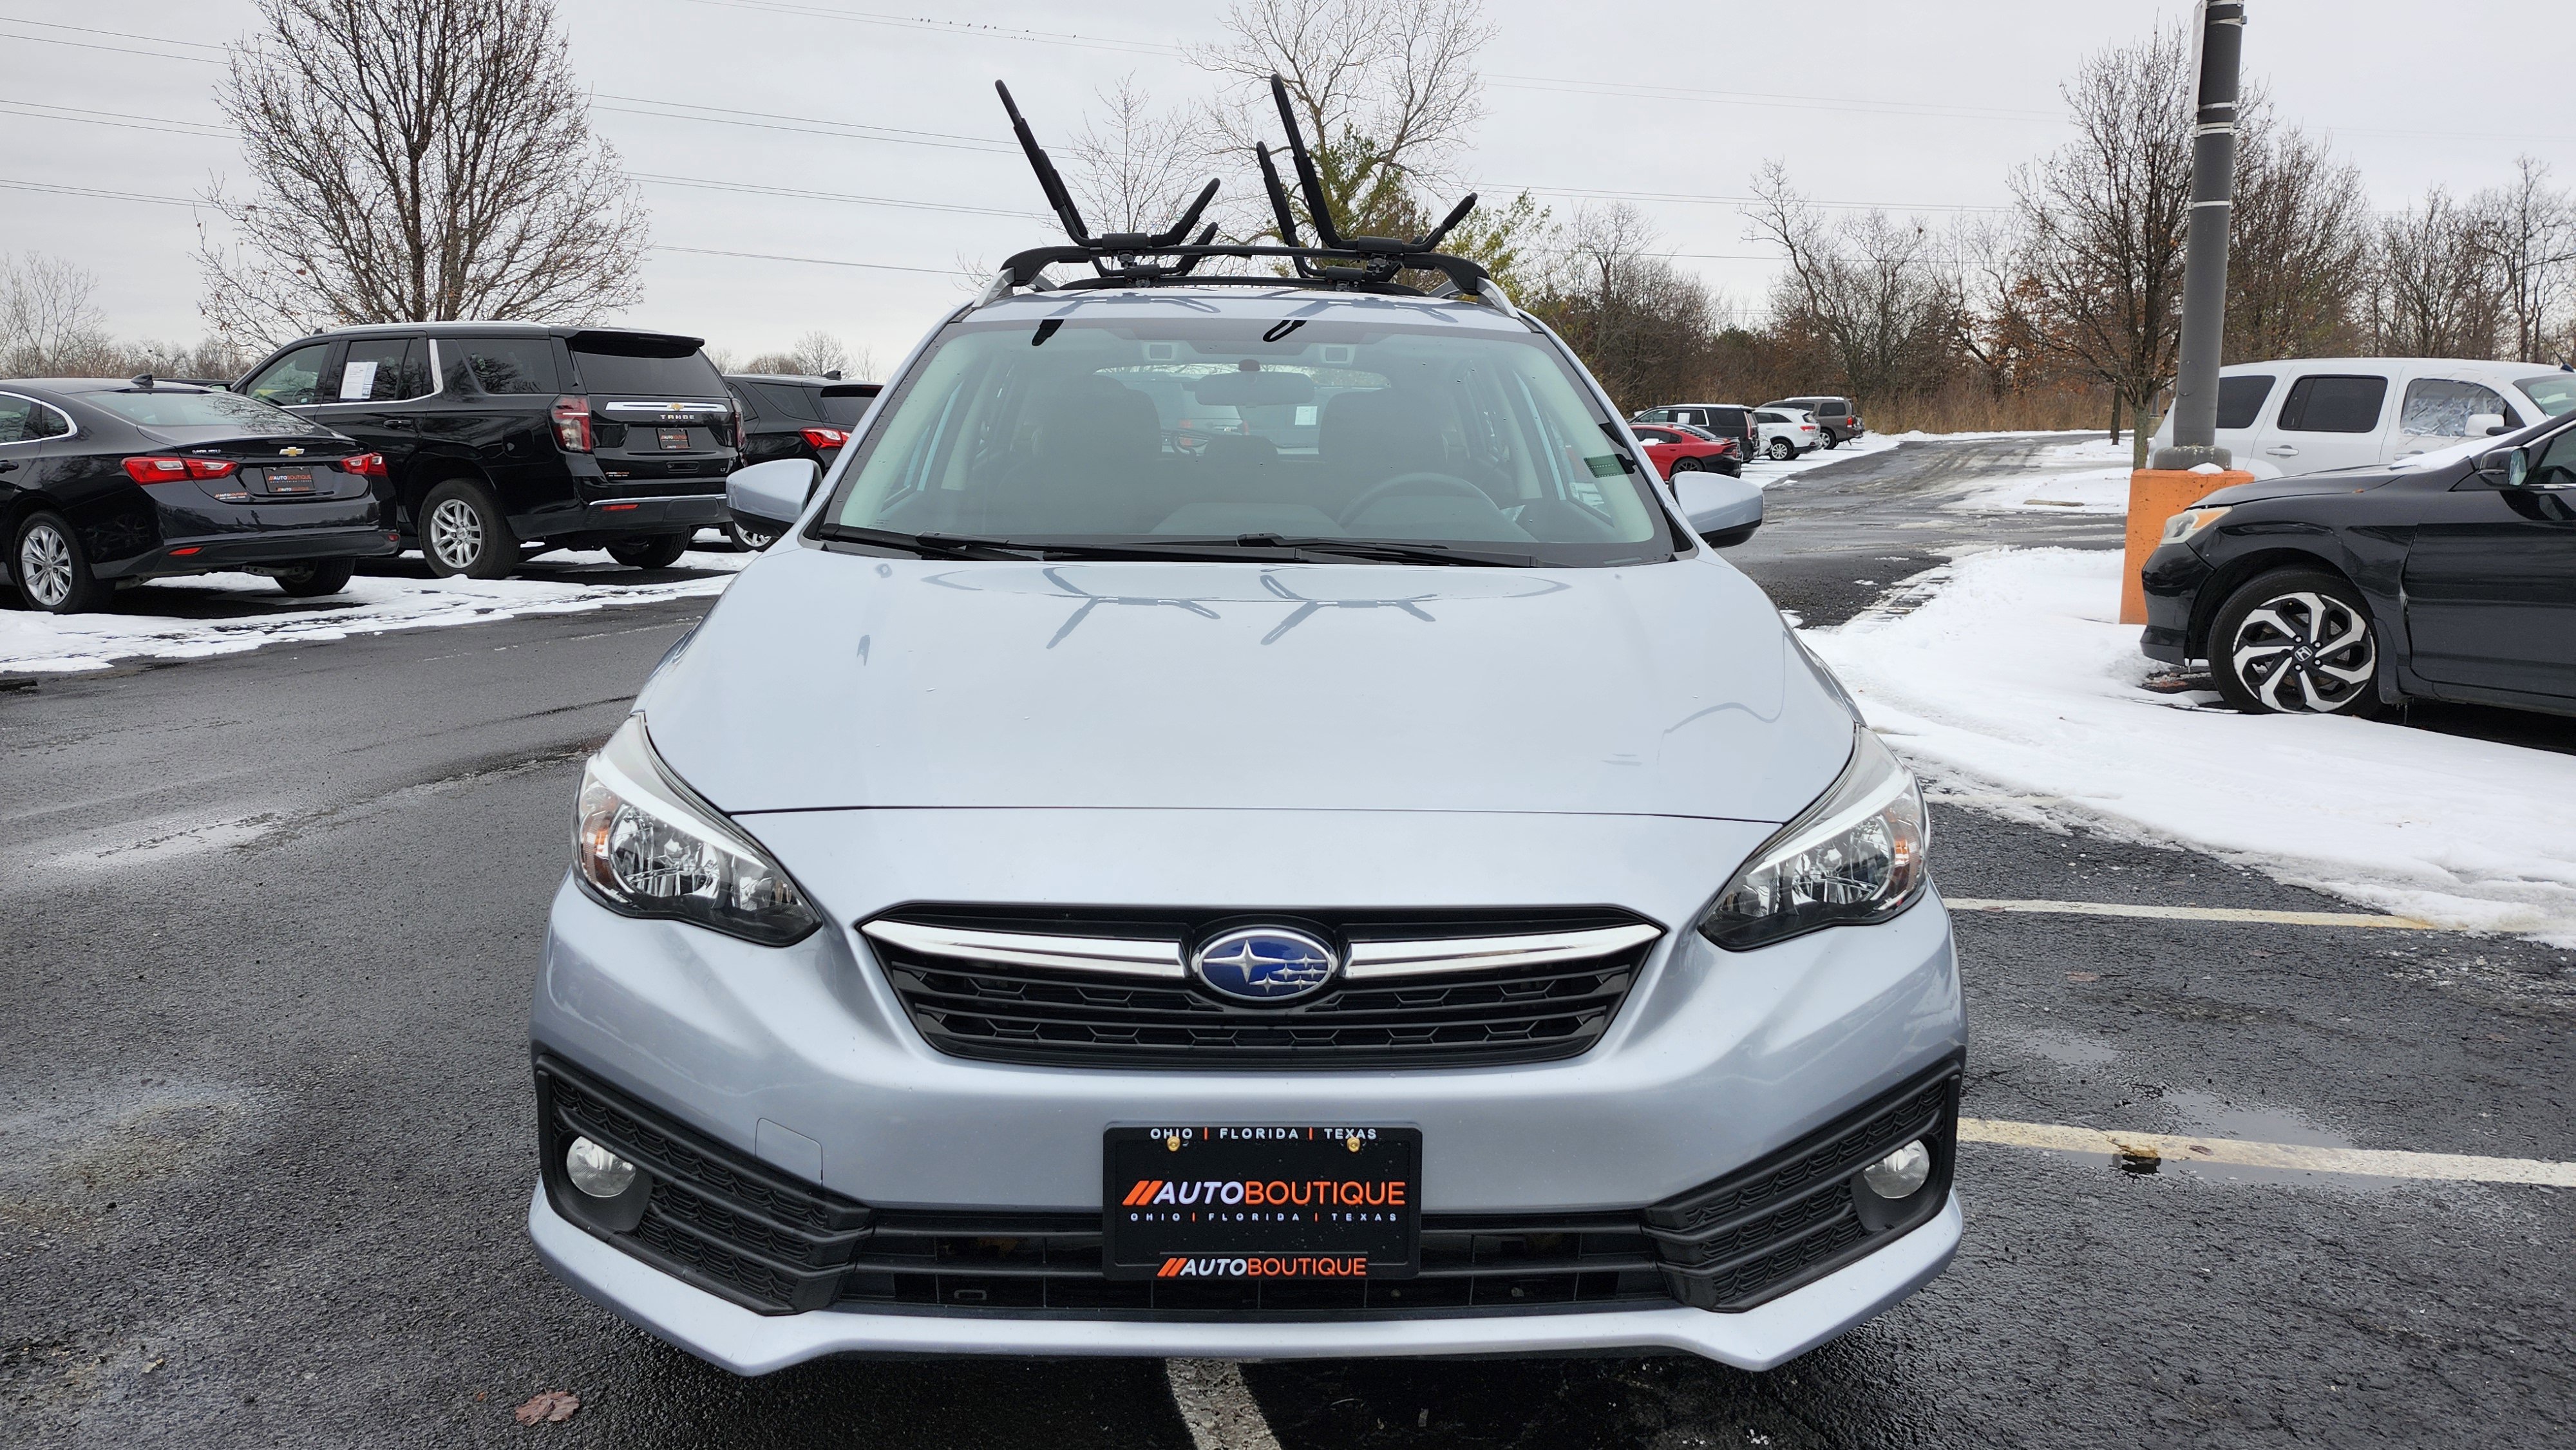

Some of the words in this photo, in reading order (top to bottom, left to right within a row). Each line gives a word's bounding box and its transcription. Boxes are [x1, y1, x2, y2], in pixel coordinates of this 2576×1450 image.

[1150, 1127, 1193, 1140] OHIO
[1219, 1127, 1299, 1140] FLORIDA
[1323, 1127, 1377, 1140] TEXAS
[1152, 1181, 1406, 1206] AUTOBOUTIQUE
[1130, 1212, 1180, 1222] OHIO
[1208, 1212, 1300, 1222] FLORIDA
[1331, 1212, 1397, 1222] TEXAS
[1180, 1257, 1367, 1276] AUTOBOUTIQUE
